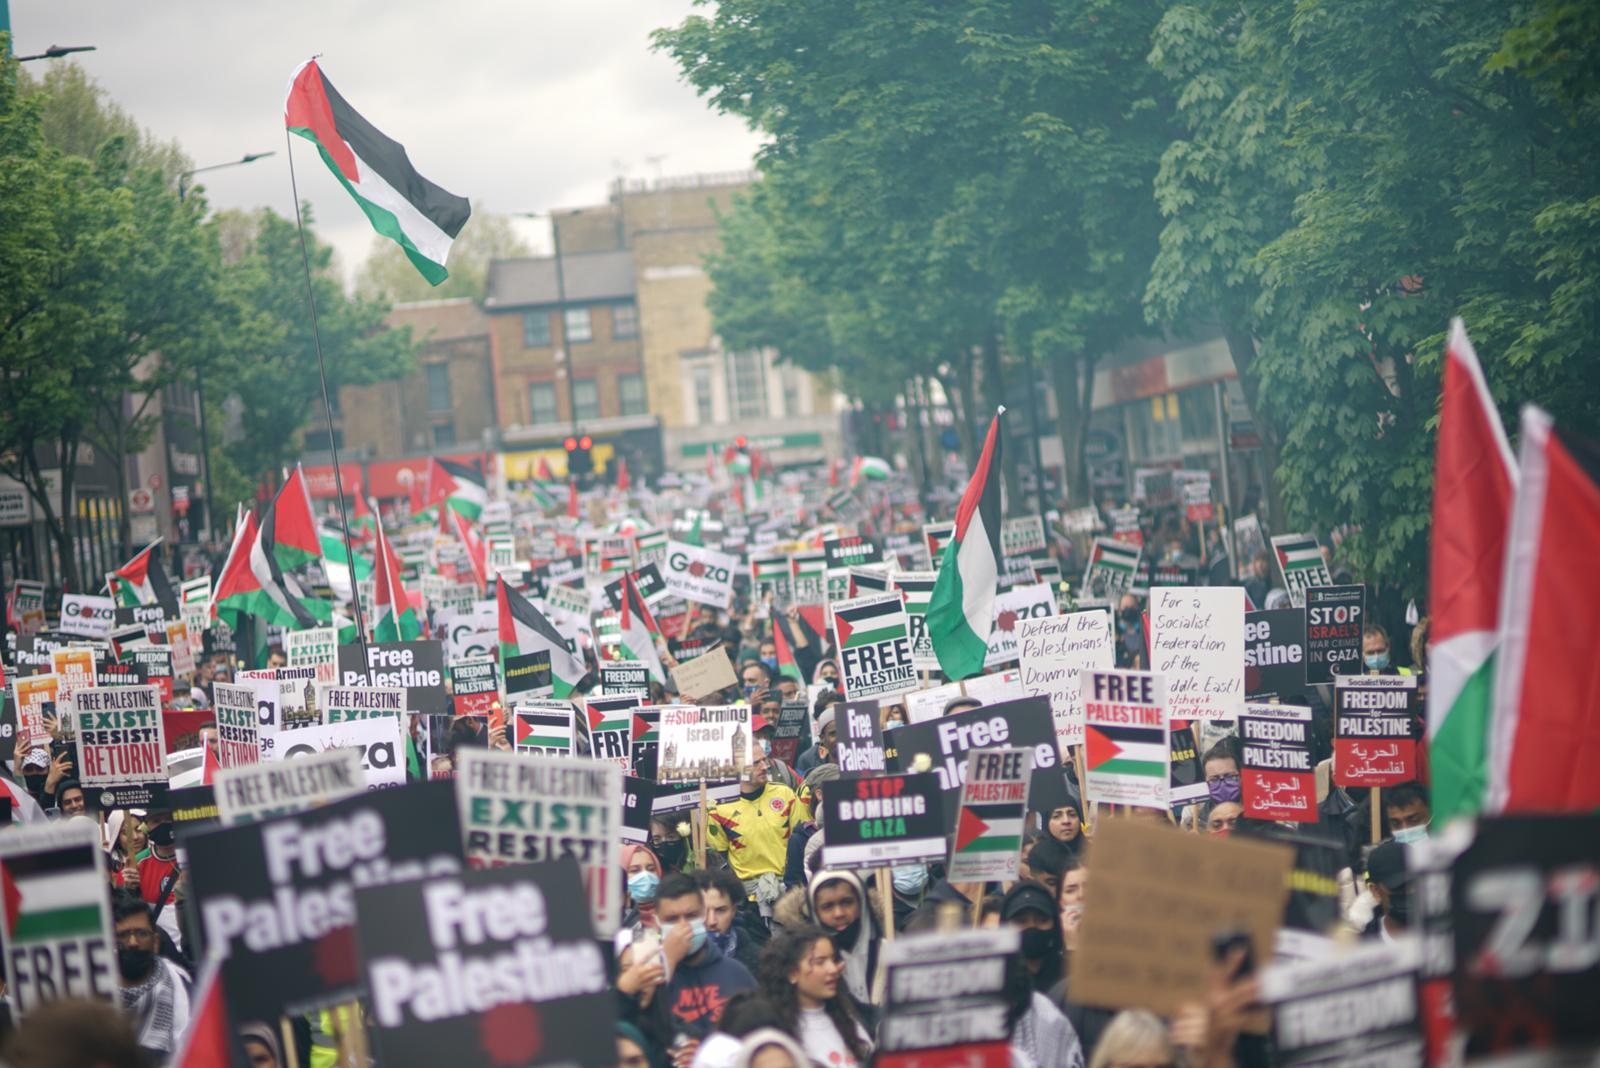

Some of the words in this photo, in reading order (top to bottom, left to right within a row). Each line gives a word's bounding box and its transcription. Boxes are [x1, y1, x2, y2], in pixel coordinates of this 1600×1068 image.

[832, 544, 874, 558] BOMBING
[670, 553, 729, 585] Gza
[1101, 568, 1132, 589] REE
[1286, 567, 1332, 592] FREE
[877, 592, 900, 602] Campaign
[1160, 592, 1183, 608] For
[1192, 599, 1201, 610] a
[65, 602, 113, 618] Gza
[133, 607, 164, 622] Free
[1310, 606, 1361, 625] STOP
[1022, 621, 1070, 639] Defend
[1077, 618, 1105, 632] the
[1155, 613, 1212, 630] Socialist
[1245, 621, 1271, 641] ee
[1309, 627, 1360, 639] ISRAEL'S
[33, 638, 61, 651] Free
[291, 643, 335, 657] EXIST!
[1023, 632, 1110, 659] Palestinians!
[1154, 638, 1226, 652] Federation
[1309, 640, 1328, 649] WAR
[1329, 638, 1360, 648] CRIMES
[136, 653, 169, 664] FREEDOM
[367, 647, 415, 667] Free
[842, 637, 913, 677] FREE
[1161, 657, 1178, 673] of
[1181, 655, 1200, 672] the
[1245, 642, 1303, 667] stine
[1310, 652, 1323, 662] IN
[1327, 650, 1360, 662] GAZA
[107, 664, 130, 674] STOP
[344, 666, 440, 688] Palestine
[454, 664, 492, 678] FREEDOM
[605, 669, 645, 684] FREEDOM
[98, 674, 139, 685] BOMBING
[454, 678, 498, 695] PALESTINE
[846, 670, 915, 690] PALESTINE
[1093, 673, 1155, 704] FREE
[1170, 677, 1200, 694] ddle
[1203, 677, 1240, 694] East!
[77, 693, 103, 711] FREE
[104, 688, 155, 711] PALESTINE
[216, 687, 228, 704] FREE
[228, 687, 256, 709] PALESTINE
[329, 690, 352, 707] FREE
[354, 690, 401, 709] PALESTINE
[1343, 691, 1408, 709] FREEDOM
[79, 710, 157, 730] EXIST!
[218, 708, 257, 729] EXIST!
[665, 707, 748, 725] #StopArming
[1086, 703, 1163, 725] PALESTINE
[1170, 705, 1225, 721] Tendency
[1369, 710, 1382, 718] for
[848, 708, 873, 739] Free
[1245, 721, 1305, 742] FREEDOM
[1340, 718, 1411, 736] PALESTINE
[81, 727, 159, 745] RESIST!
[220, 726, 258, 745] RESIST!
[687, 725, 724, 743] Israel
[939, 716, 1009, 755] Free
[83, 742, 163, 778] RETURN!
[838, 741, 887, 773] Palestine
[1244, 747, 1311, 769] PALESTINE
[1351, 743, 1399, 760] الحرية
[974, 752, 1024, 781] FREE
[226, 772, 268, 808] FREE
[270, 758, 357, 803] PALESTINE
[469, 760, 513, 796] FREE
[517, 765, 608, 801] PALESTINE
[857, 778, 905, 800] STOP
[1256, 774, 1300, 792] الحرية
[965, 782, 1026, 801] PALESTINE
[469, 795, 608, 836] EXIST!
[839, 795, 926, 821] BOMBING
[860, 818, 907, 839] GAZA
[264, 809, 385, 884] Free
[468, 830, 609, 866] RESIST!
[426, 885, 547, 949] Free
[11, 939, 117, 1014] FREE
[371, 938, 606, 1027] Palestine
